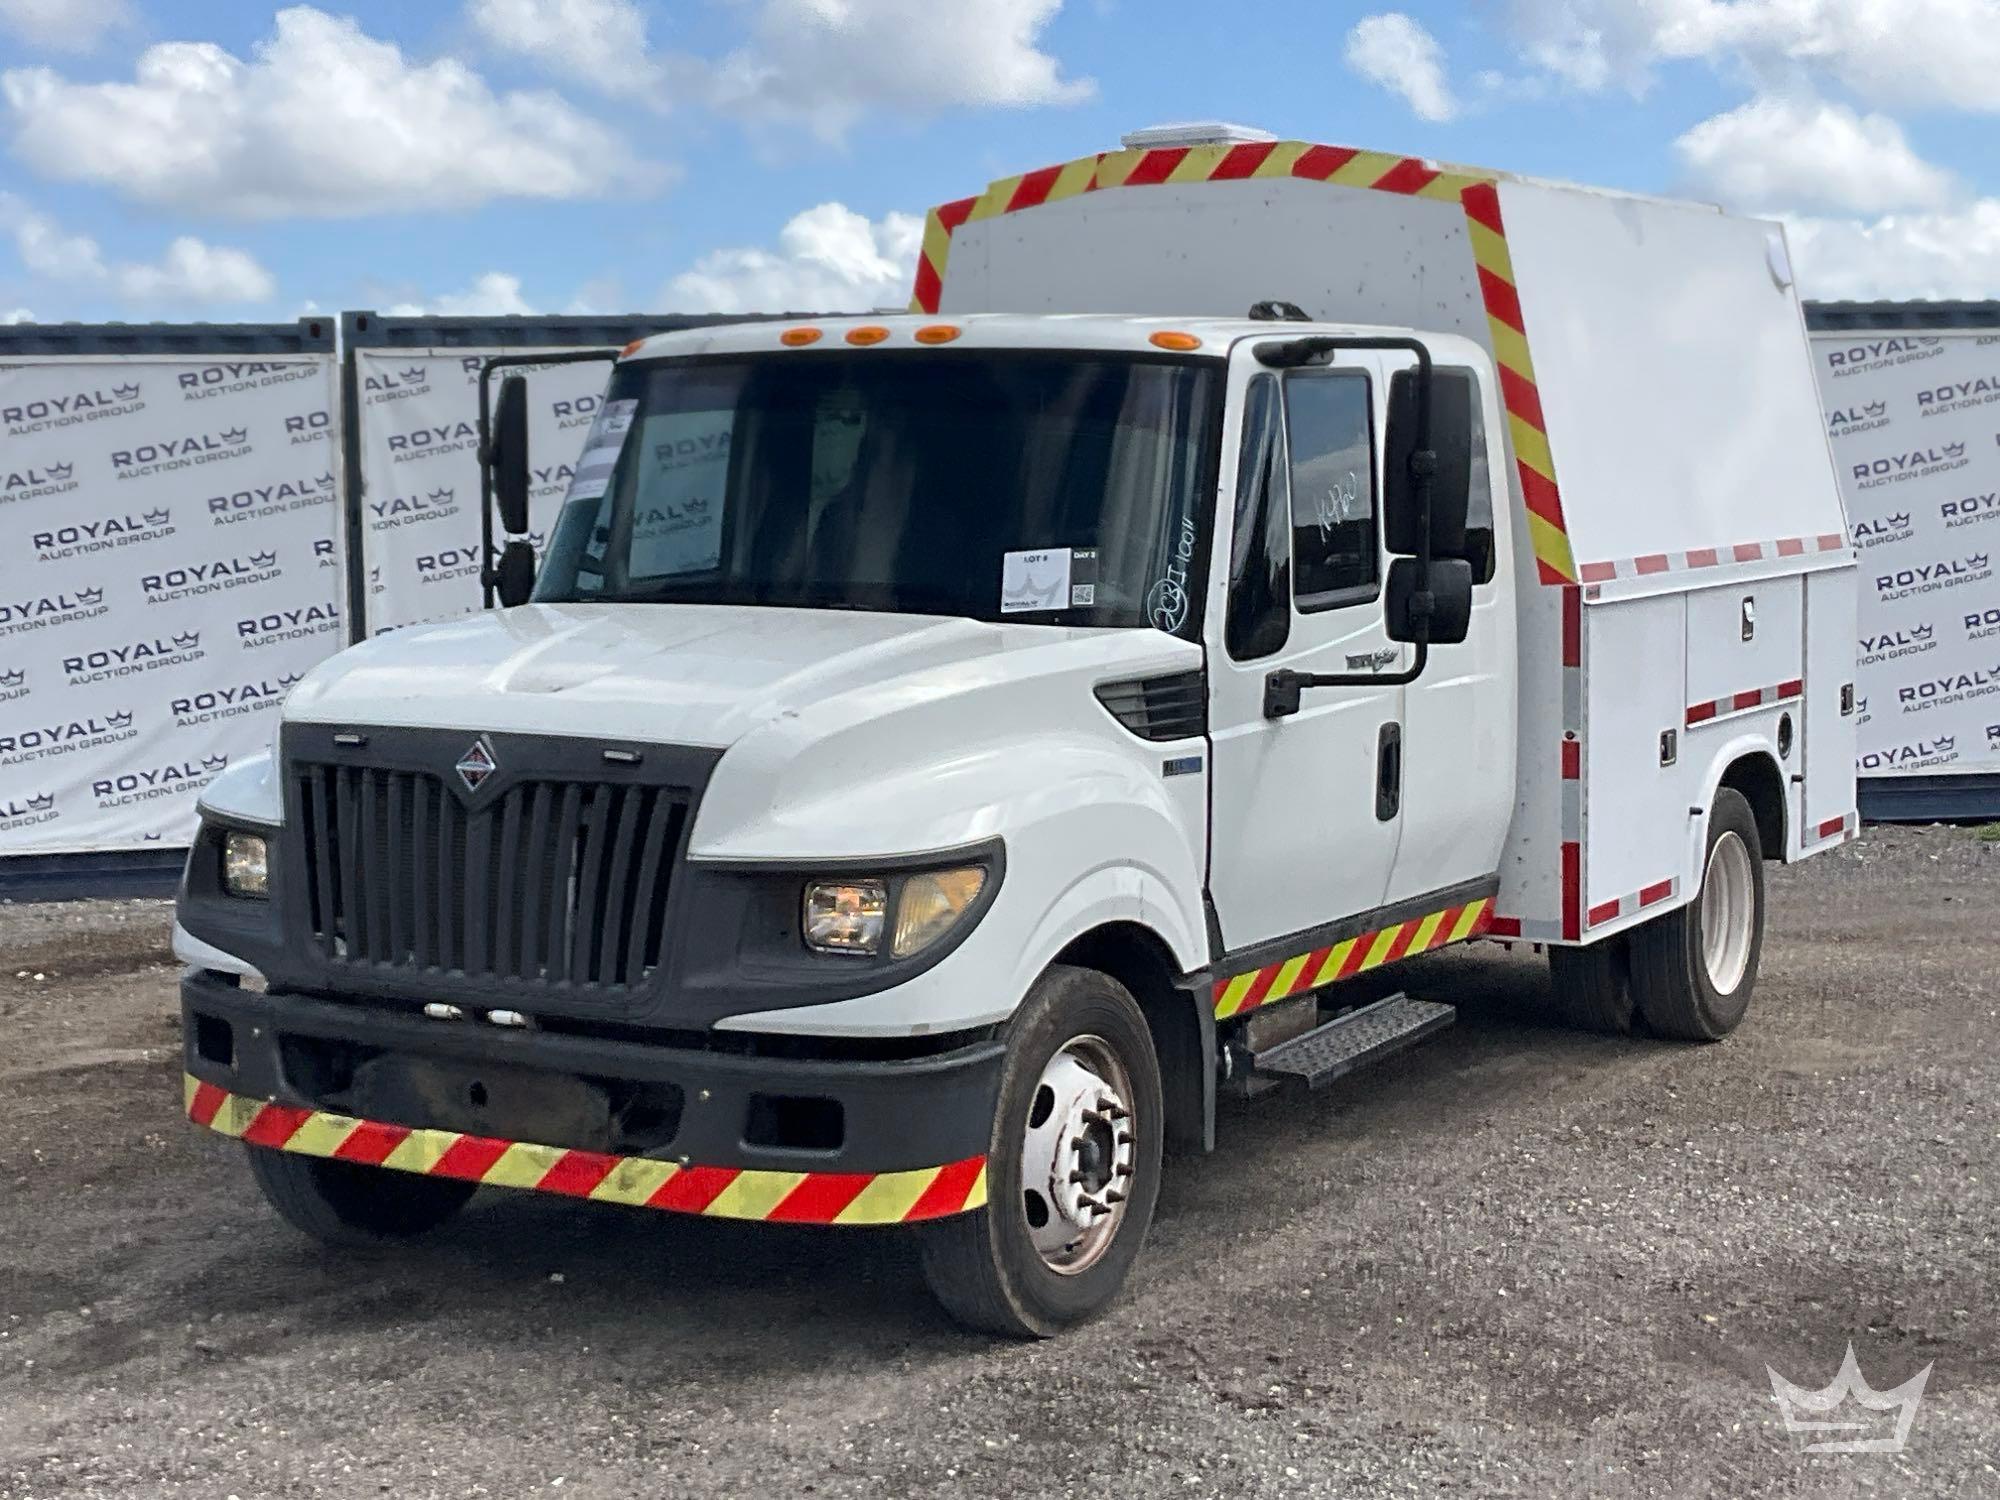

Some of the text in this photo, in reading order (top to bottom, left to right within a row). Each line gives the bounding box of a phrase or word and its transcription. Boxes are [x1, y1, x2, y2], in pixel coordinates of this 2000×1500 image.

[1832, 346, 1944, 378] AUCTION GROUP
[183, 366, 320, 401] AUCTION GROUP
[374, 385, 432, 405] GROUP
[3, 390, 113, 424] ROYAL
[8, 402, 146, 436] AUCTION GROUP
[1921, 398, 1983, 418] AUCTION
[388, 419, 481, 451] ROYA
[1841, 417, 1891, 436] GROUP
[112, 434, 221, 468] ROYAL
[117, 445, 253, 480] AUCTION GROUP
[393, 442, 460, 464] AUCTION
[1853, 448, 1943, 480] ROYAL
[1857, 458, 1969, 490] AUCTION GROUP
[19, 481, 79, 501] GROUP
[208, 479, 316, 513] ROYAL
[213, 502, 287, 526] AUCTION
[403, 506, 460, 526] GROUP
[33, 515, 144, 550] ROYAL
[39, 526, 176, 562] AUCTION GROUP
[1865, 529, 1915, 548] GROUP
[141, 558, 250, 593] ROYAL
[147, 568, 282, 605] AUCTION GROUP
[1875, 560, 1966, 592] ROYAL
[1880, 570, 1993, 602] AUCTION GROUP
[50, 605, 109, 626] GROUP
[237, 602, 339, 637] ROYAL
[242, 627, 316, 650] AUCTION
[1859, 631, 1911, 653] YAL
[1888, 641, 1938, 659] GROUP
[63, 639, 174, 674] ROYAL
[68, 650, 206, 687] AUCTION GROUP
[171, 681, 279, 716] ROYAL
[1899, 671, 1988, 703] ROYAL
[176, 705, 251, 728] AUCTION
[1902, 694, 1965, 714] AUCTION
[1, 729, 138, 767] AUCTION GROUP
[1910, 752, 1960, 769] GROUP
[92, 763, 202, 797] ROYAL
[98, 786, 172, 809] AUCTION
[0, 810, 60, 832] GROUP
